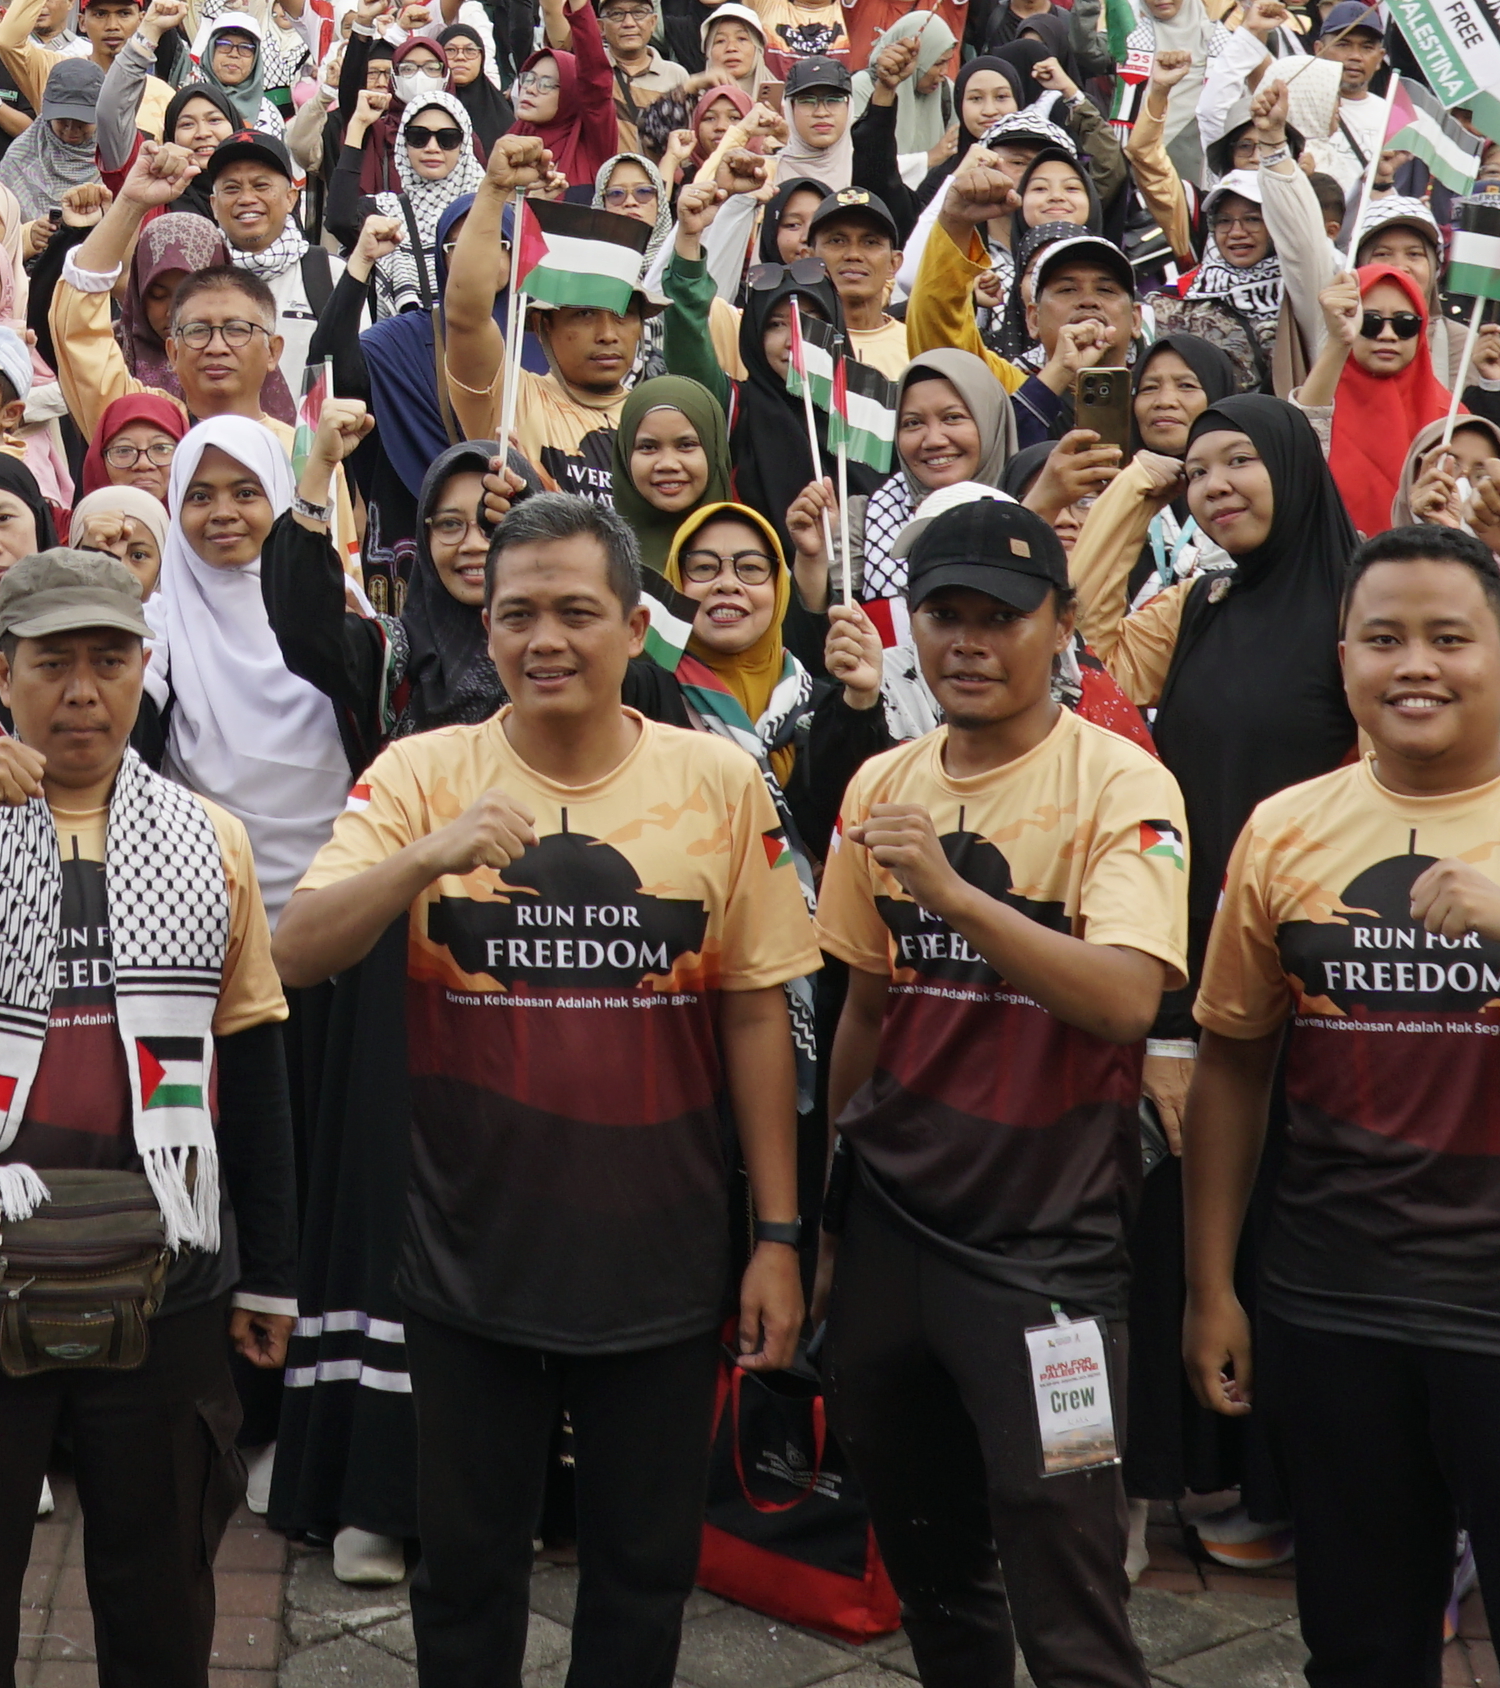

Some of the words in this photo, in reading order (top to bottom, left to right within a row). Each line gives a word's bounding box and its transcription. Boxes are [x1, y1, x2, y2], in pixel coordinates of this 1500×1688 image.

[1444, 0, 1484, 50] FREE
[516, 905, 575, 927] RUN
[584, 905, 641, 927] FOR
[1353, 926, 1416, 949] RUN
[485, 939, 670, 970] FREEDOM
[484, 994, 553, 1009] Kebebasan
[556, 995, 601, 1010] Adalah
[604, 996, 629, 1009] Hak
[73, 1013, 116, 1027] Adalah
[1325, 1018, 1393, 1033] Kebebasan
[1396, 1020, 1443, 1034] Adalah
[1446, 1021, 1472, 1034] Hak
[1039, 1362, 1099, 1382] PALESTINE
[1045, 1361, 1068, 1373] RUN
[1071, 1356, 1092, 1369] FOR
[1050, 1385, 1095, 1414] Crew
